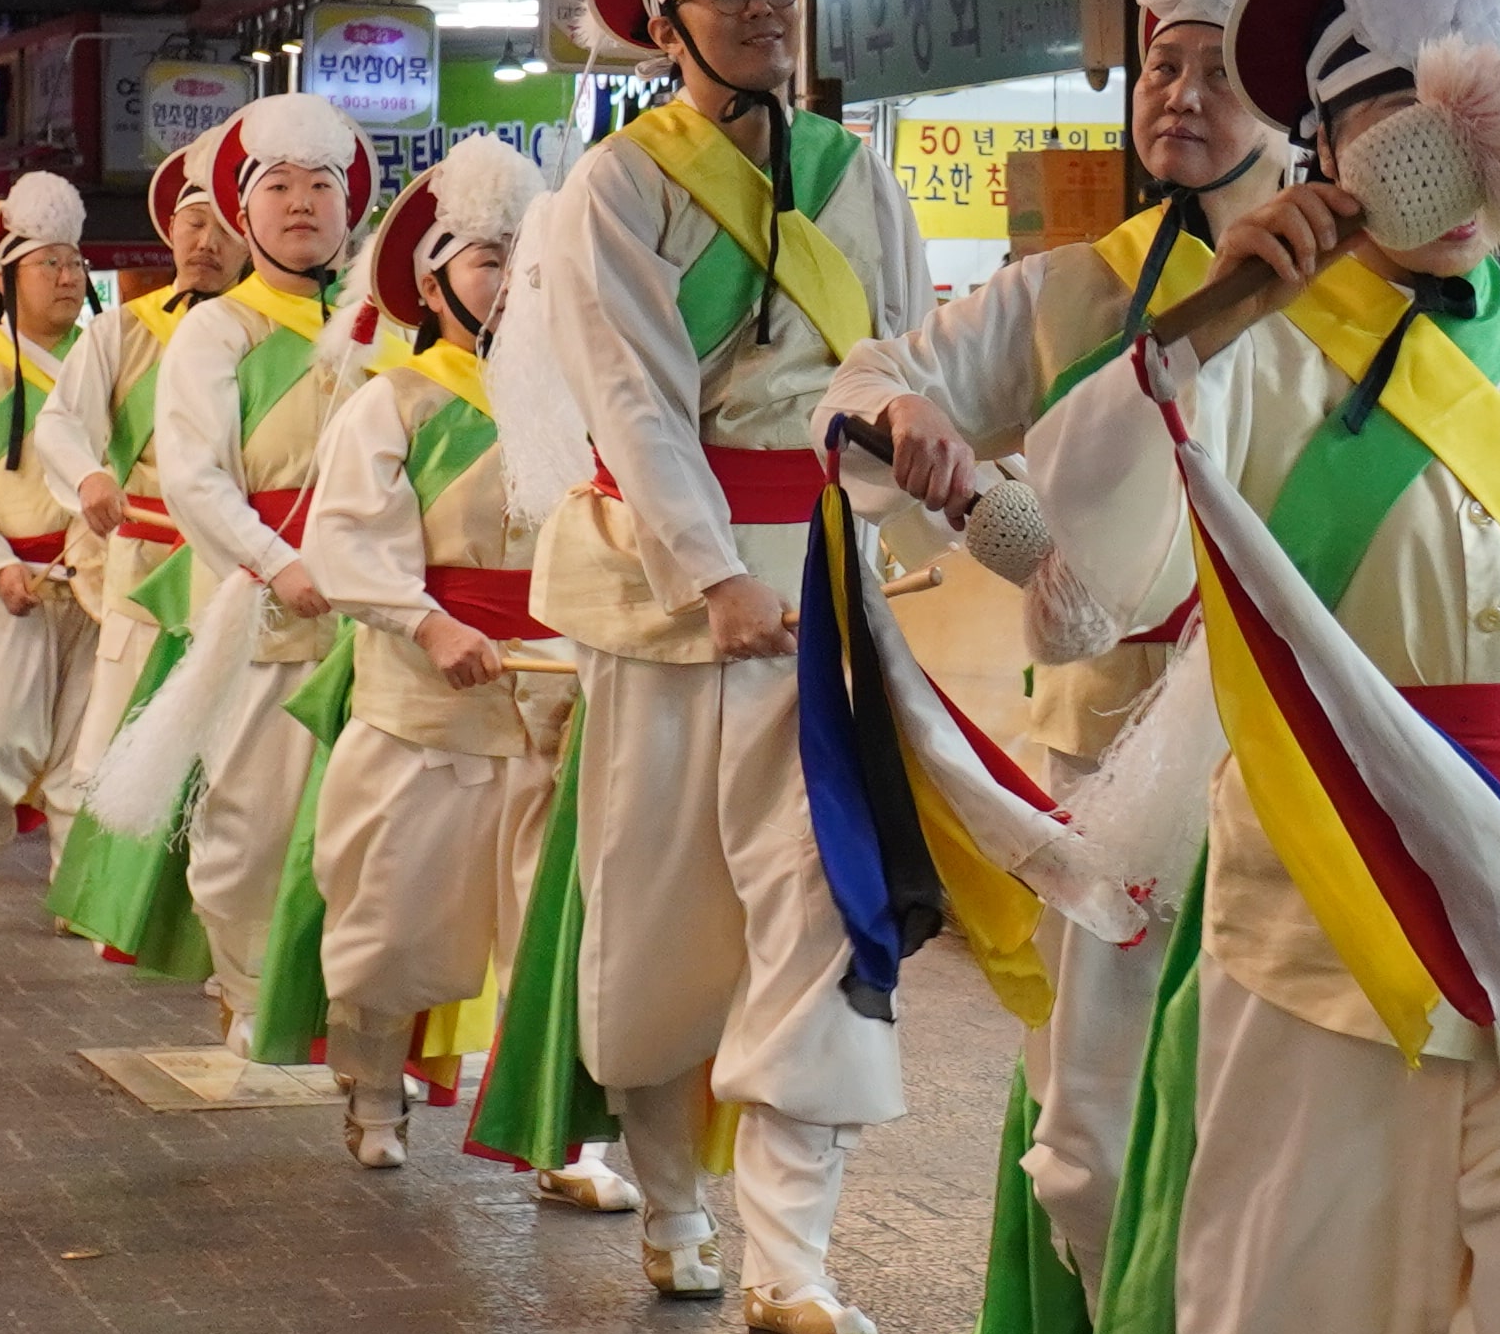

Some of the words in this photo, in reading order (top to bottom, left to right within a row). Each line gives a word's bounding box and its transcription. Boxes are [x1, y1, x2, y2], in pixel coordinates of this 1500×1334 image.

[919, 125, 962, 155] 50
[973, 126, 995, 156] 년
[899, 163, 972, 207] 고소한
